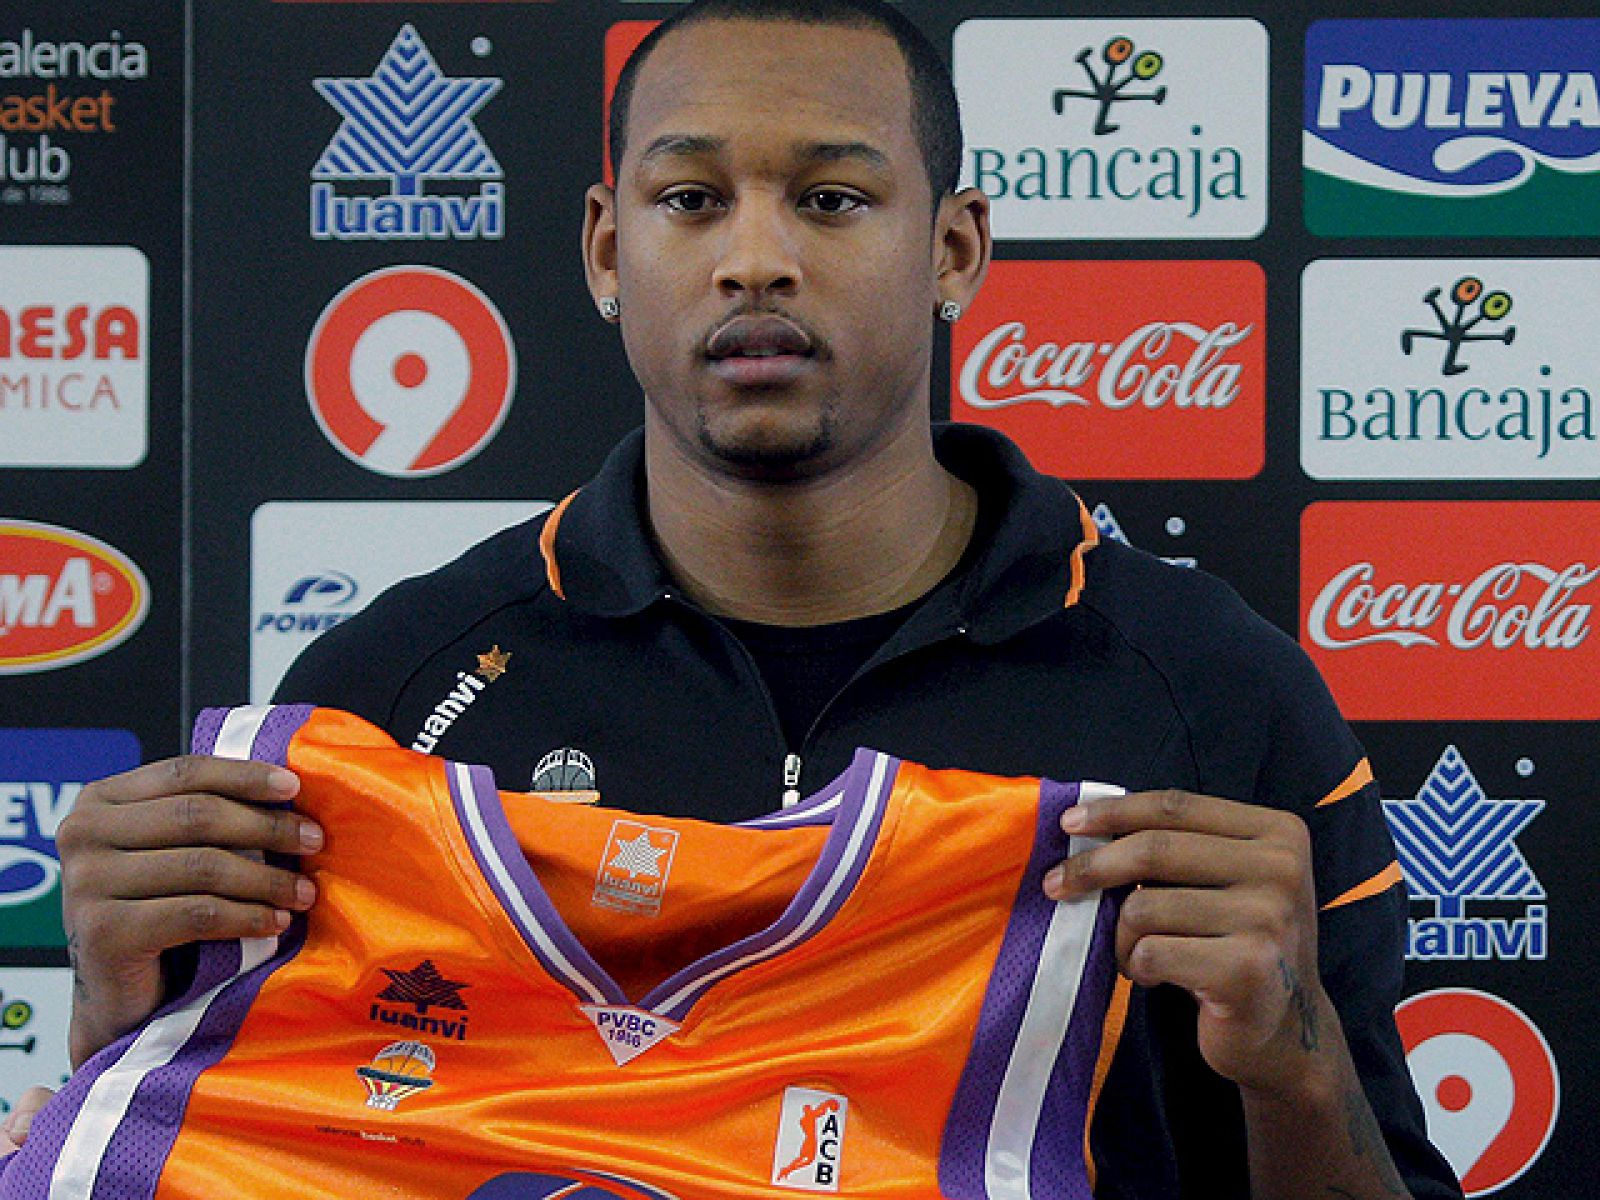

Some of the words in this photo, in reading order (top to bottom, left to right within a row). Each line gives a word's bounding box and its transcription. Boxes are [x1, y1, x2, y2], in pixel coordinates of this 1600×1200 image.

[0, 28, 148, 78] alencia
[0, 84, 116, 132] asket
[1317, 64, 1600, 130] PULEVA
[969, 124, 1248, 218] Bancaja
[310, 182, 505, 240] luanvi
[959, 320, 1255, 410] Coca-Cola
[1316, 364, 1598, 459] Bancaja
[255, 612, 353, 633] POWE
[1307, 561, 1600, 650] Coca-Cola
[1405, 904, 1549, 961] anvi
[369, 1002, 469, 1042] luanvi
[597, 1006, 656, 1037] PVBC
[814, 1114, 839, 1186] ACB
